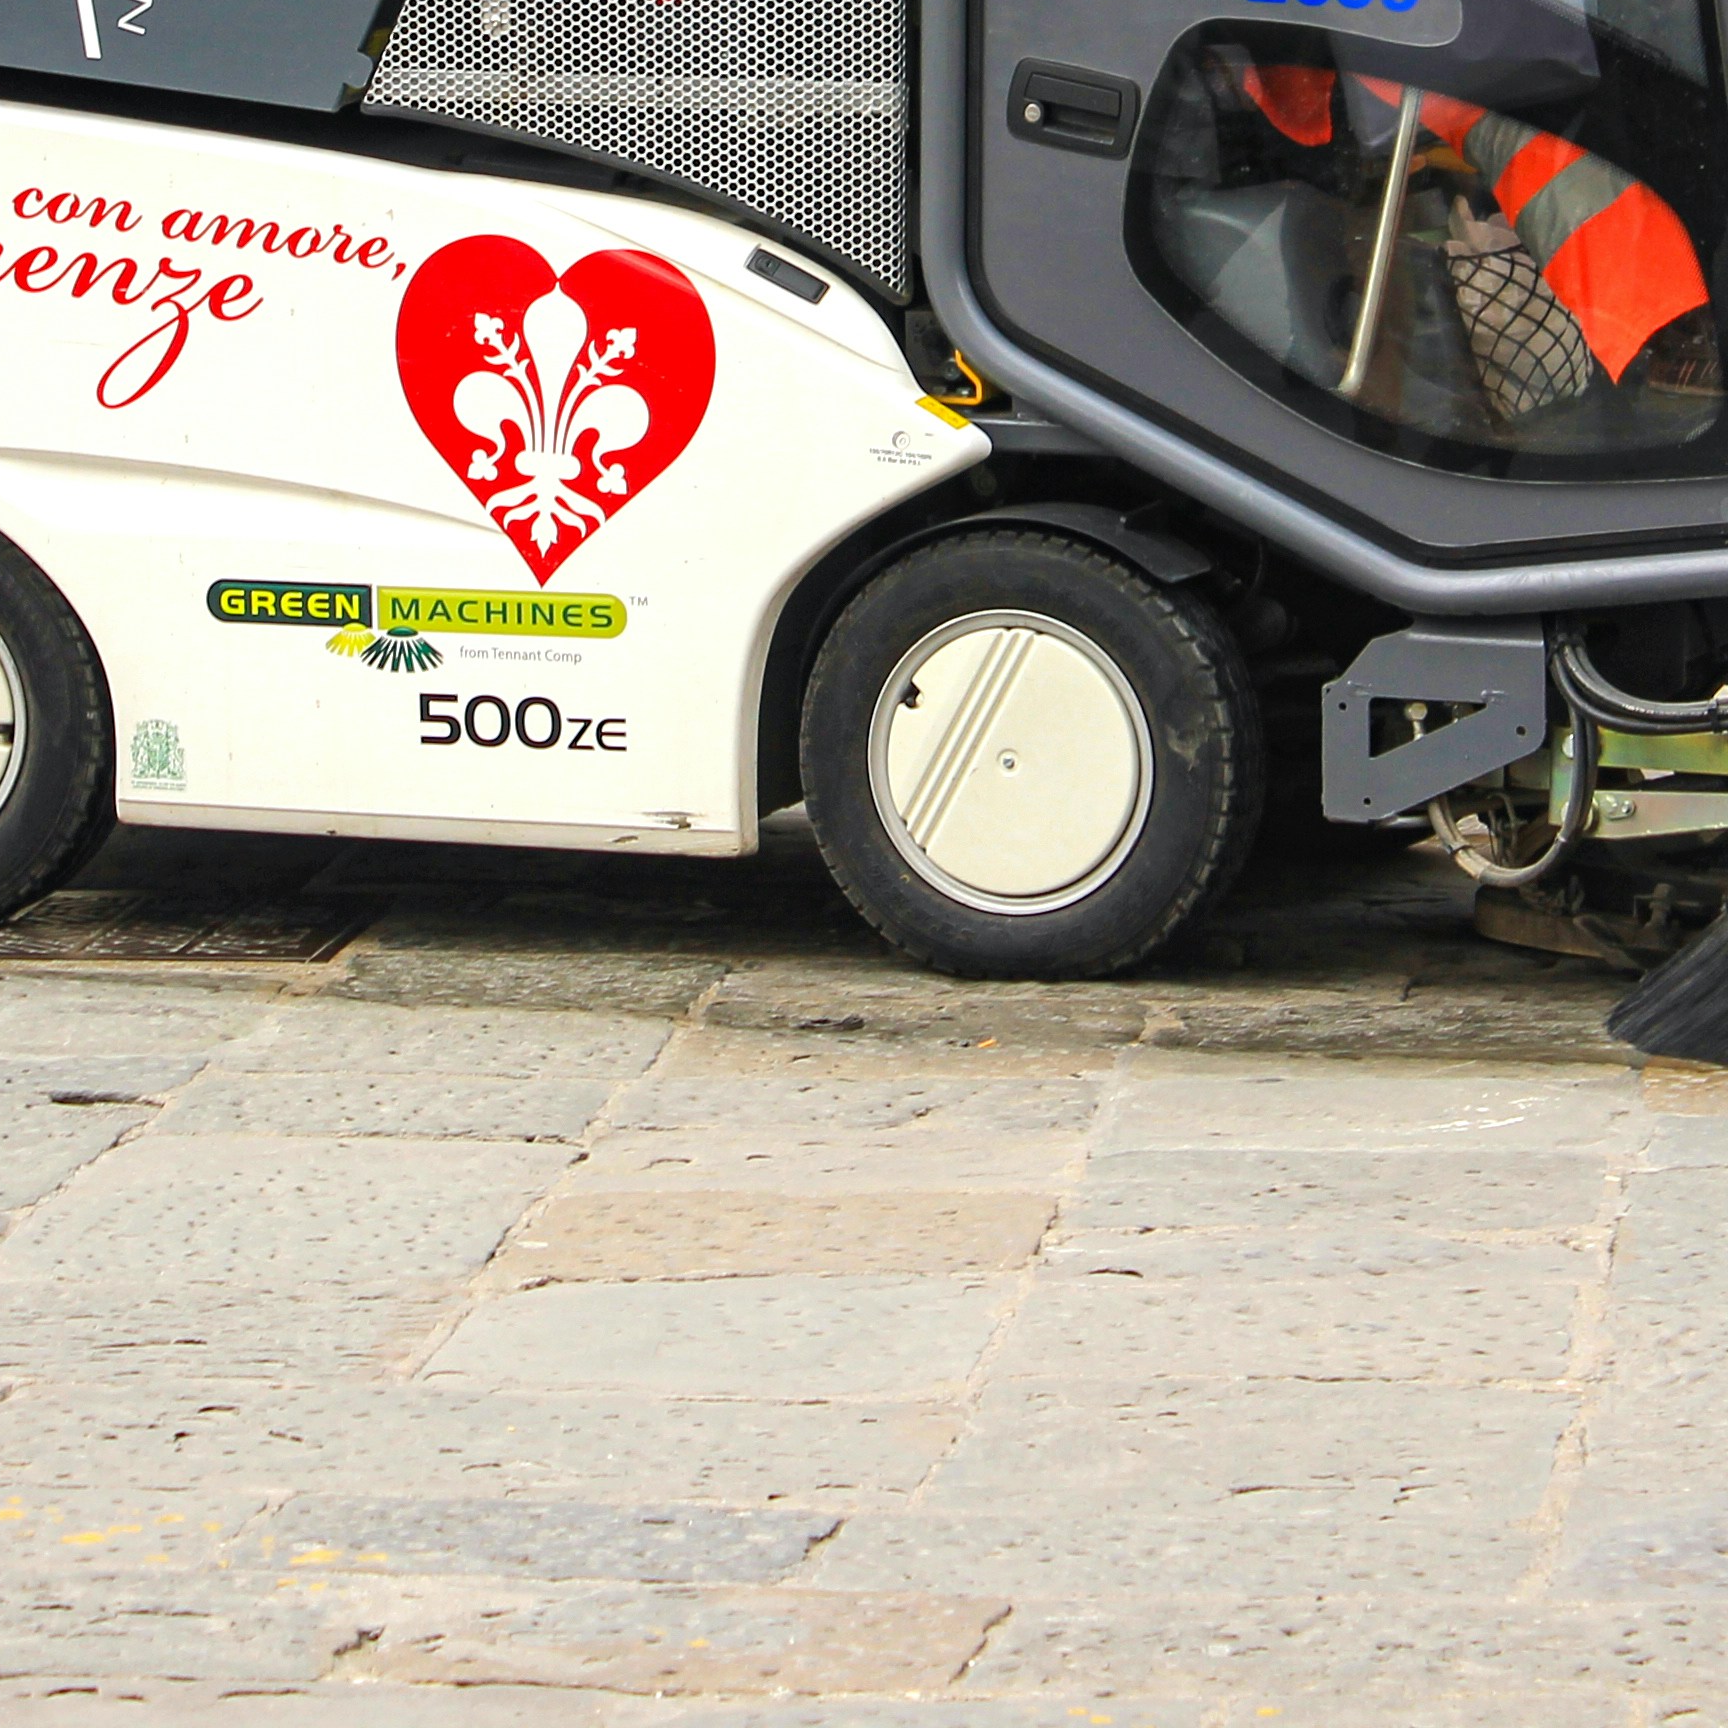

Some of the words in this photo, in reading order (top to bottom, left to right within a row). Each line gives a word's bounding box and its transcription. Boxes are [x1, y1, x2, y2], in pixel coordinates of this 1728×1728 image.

[12, 184, 140, 234] con
[160, 207, 412, 282] amore,
[220, 588, 362, 620] GREEN
[391, 595, 614, 629] MACHINES
[459, 645, 489, 659] from
[491, 647, 542, 662] Tennant
